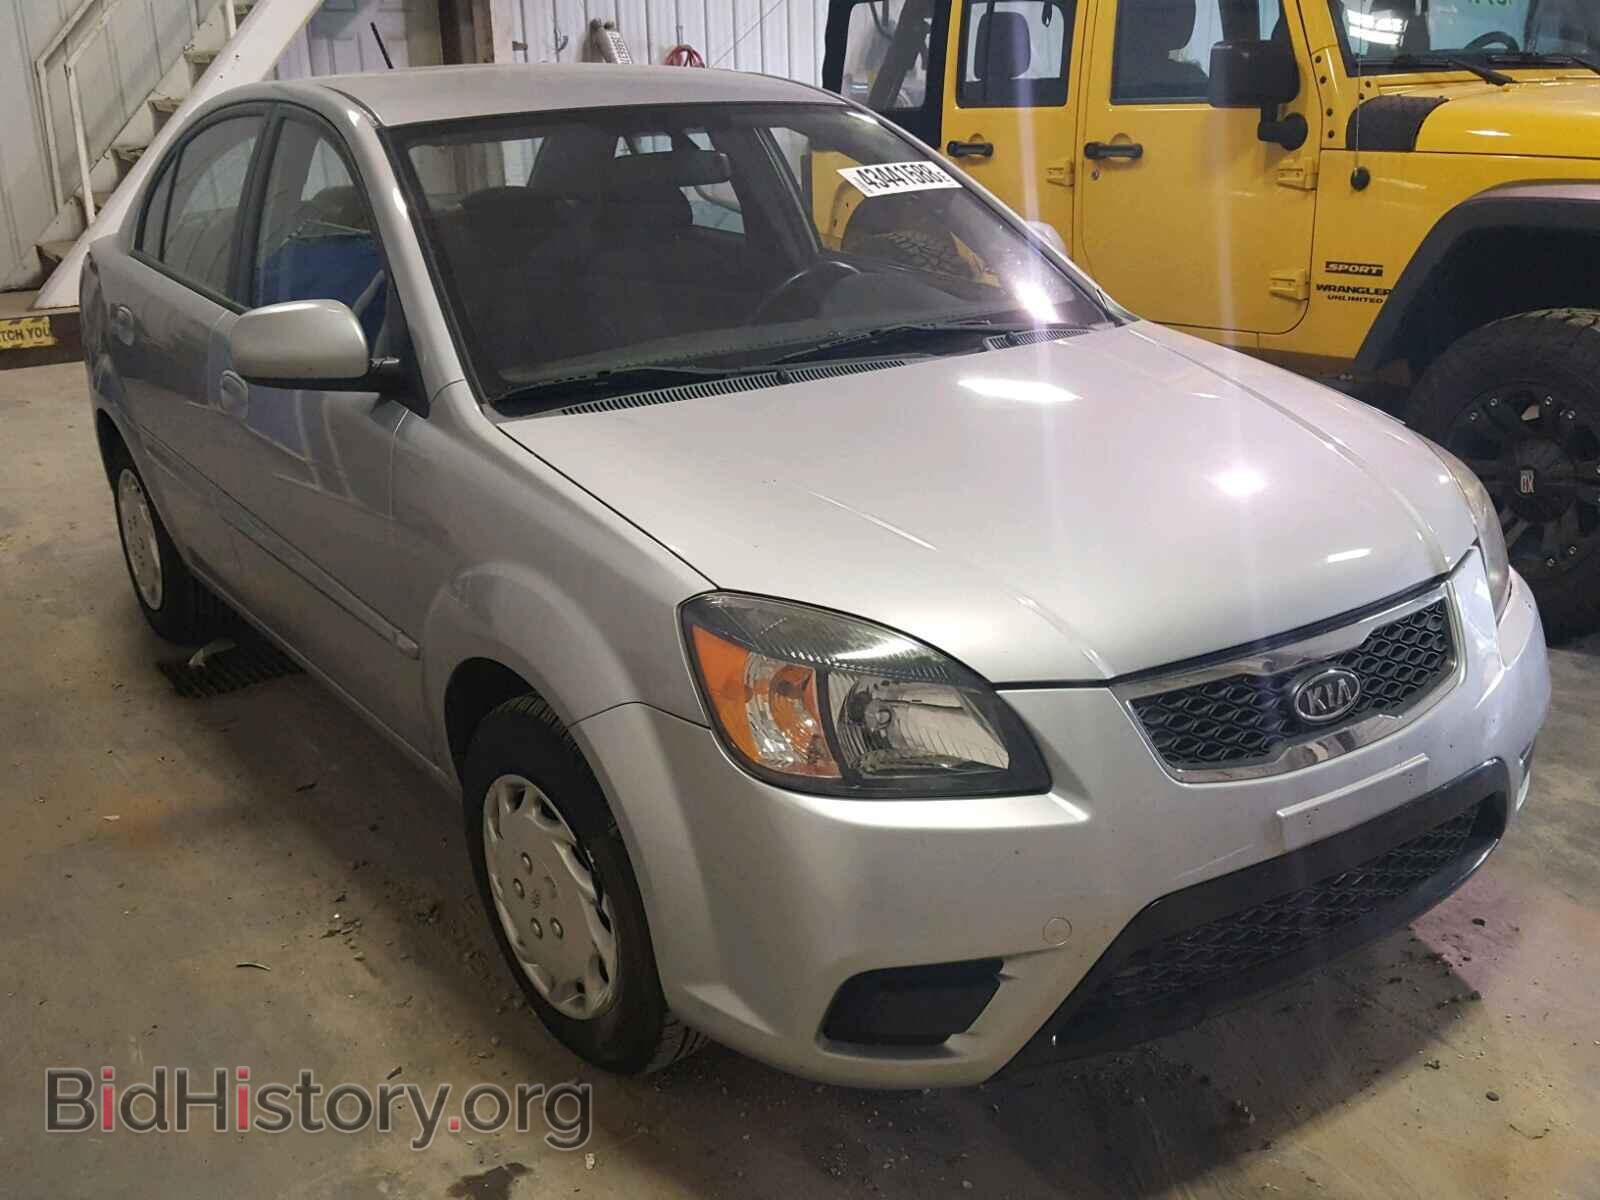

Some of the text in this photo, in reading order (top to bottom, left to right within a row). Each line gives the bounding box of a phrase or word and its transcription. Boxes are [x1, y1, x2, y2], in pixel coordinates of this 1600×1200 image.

[1327, 263, 1379, 274] SPORT
[1327, 294, 1384, 304] UNLIMITED
[1306, 679, 1352, 714] KIA
